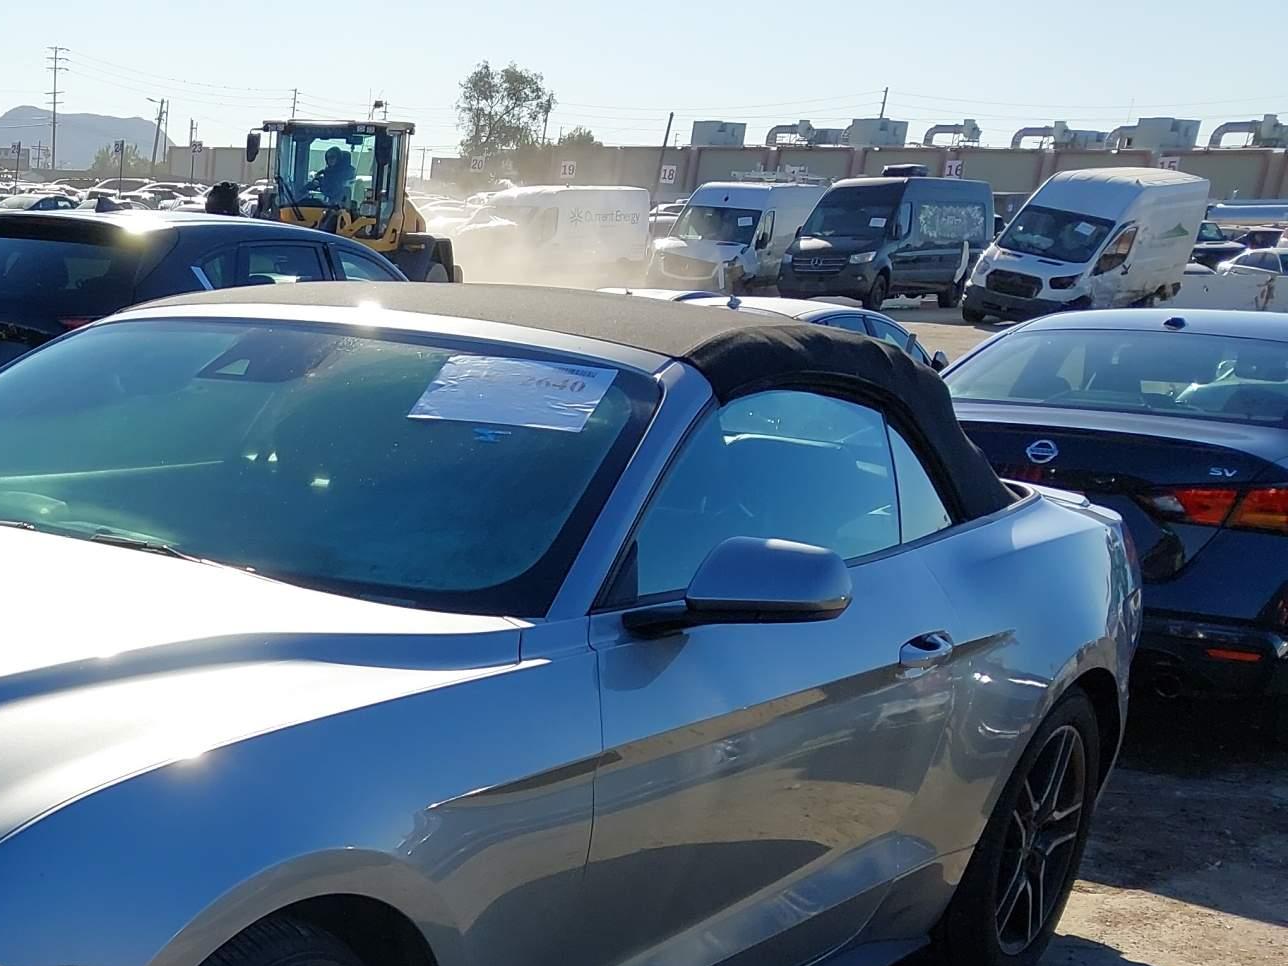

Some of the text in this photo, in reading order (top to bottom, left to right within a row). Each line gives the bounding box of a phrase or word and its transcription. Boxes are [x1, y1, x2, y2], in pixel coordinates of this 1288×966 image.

[192, 144, 202, 153] 23
[471, 158, 483, 170] 20
[562, 164, 575, 176] 19
[663, 168, 675, 180] 18
[1209, 467, 1237, 477] SV
